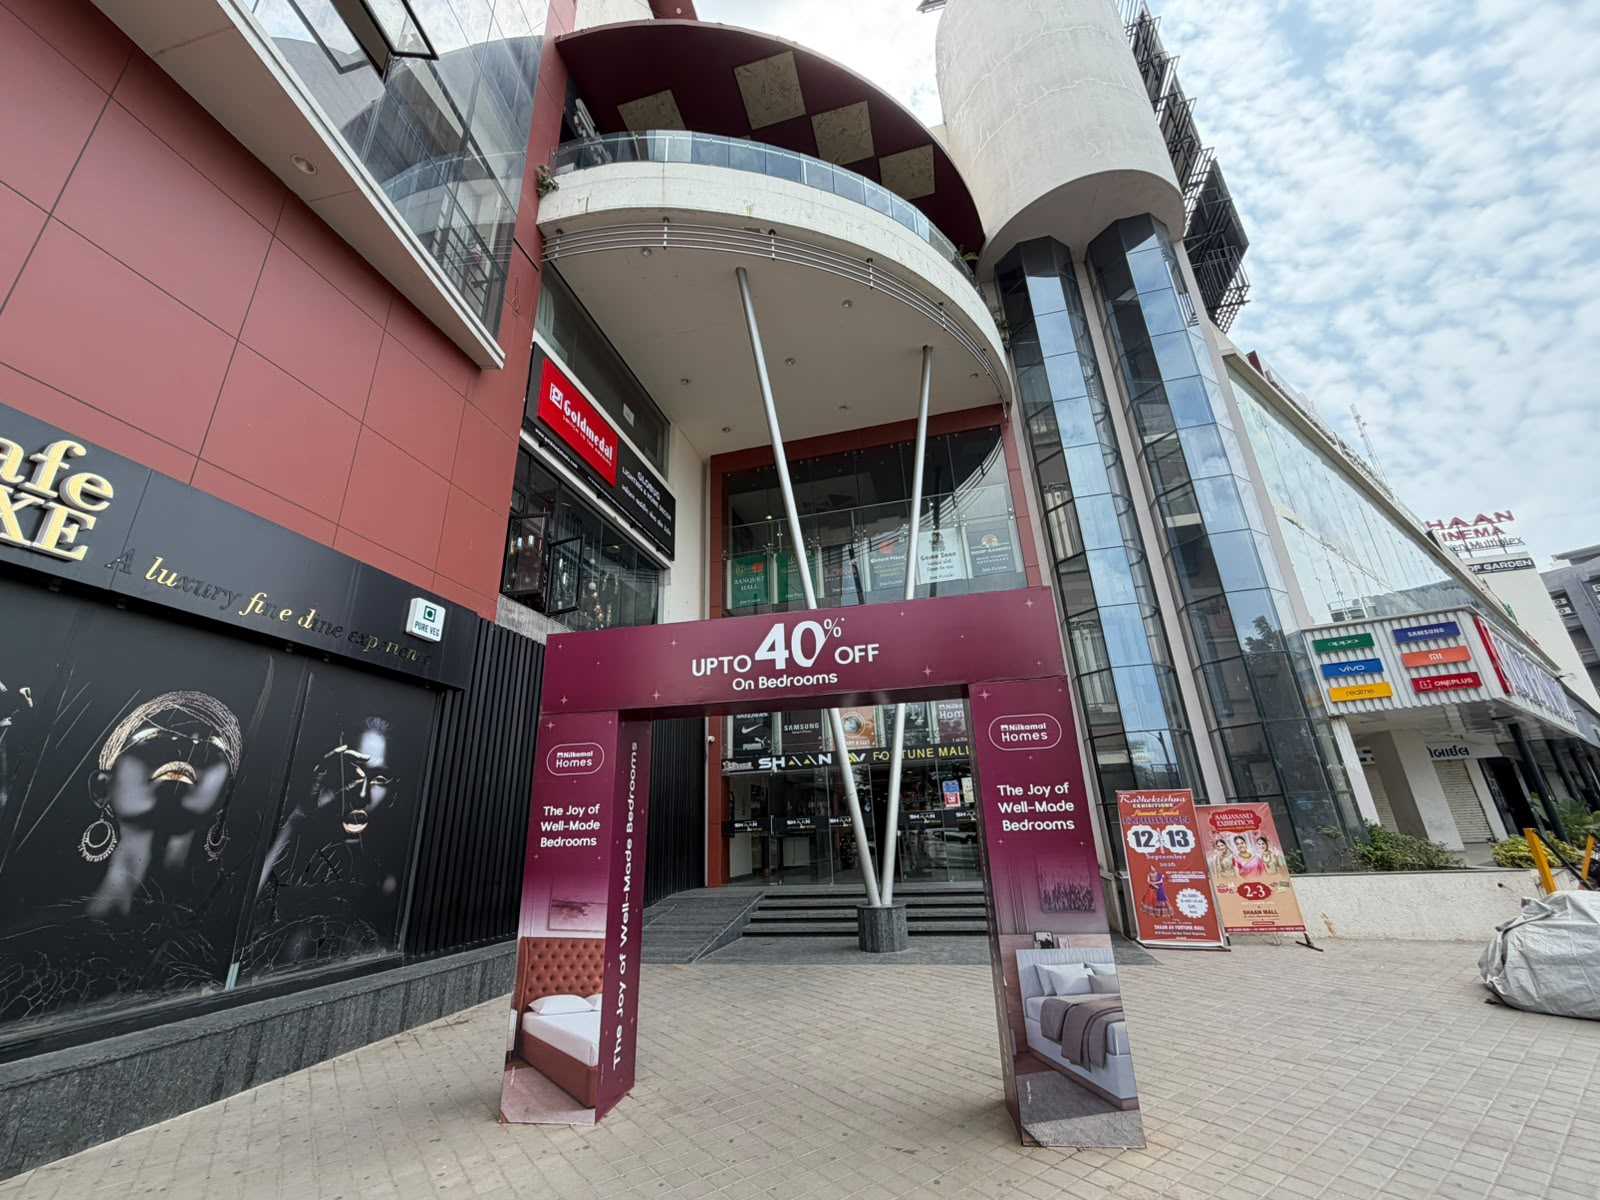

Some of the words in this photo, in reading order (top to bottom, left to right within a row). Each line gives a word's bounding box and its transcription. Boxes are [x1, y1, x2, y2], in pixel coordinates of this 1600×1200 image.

[563, 399, 613, 461] Goldmedal
[1483, 559, 1532, 570] GARDEN
[238, 591, 293, 622] fine
[414, 621, 429, 632] PURE
[430, 625, 440, 637] VEG
[1407, 627, 1445, 637] SAMSUNG
[691, 655, 752, 677] UPTO
[834, 643, 880, 665] OFF
[1338, 664, 1365, 672] vivo
[732, 677, 755, 691] On
[758, 672, 838, 689] Bedrooms
[1433, 677, 1473, 687] ONEPLUS
[783, 722, 820, 732] SAMSUNG
[1001, 731, 1048, 742] Homes
[556, 758, 593, 769] Homes
[758, 753, 832, 769] SHAAN
[873, 747, 934, 761] FOTUNE
[626, 741, 638, 833] Bedrooms
[996, 784, 1024, 796] The
[1027, 784, 1051, 798] Joy
[1054, 781, 1070, 795] of
[543, 805, 564, 816] The
[566, 805, 586, 817] Joy
[587, 803, 601, 815] of
[997, 800, 1075, 814] Well-Made
[540, 819, 601, 832] Well-Made
[1002, 818, 1076, 832] Bedrooms
[540, 836, 597, 848] Bedrooms
[1132, 830, 1155, 847] 12
[1166, 830, 1190, 847] 13
[620, 837, 633, 948] Well-Made
[1243, 885, 1266, 897] 2-3
[619, 953, 627, 974] of
[616, 983, 627, 1018] Joy
[612, 1026, 623, 1071] The
